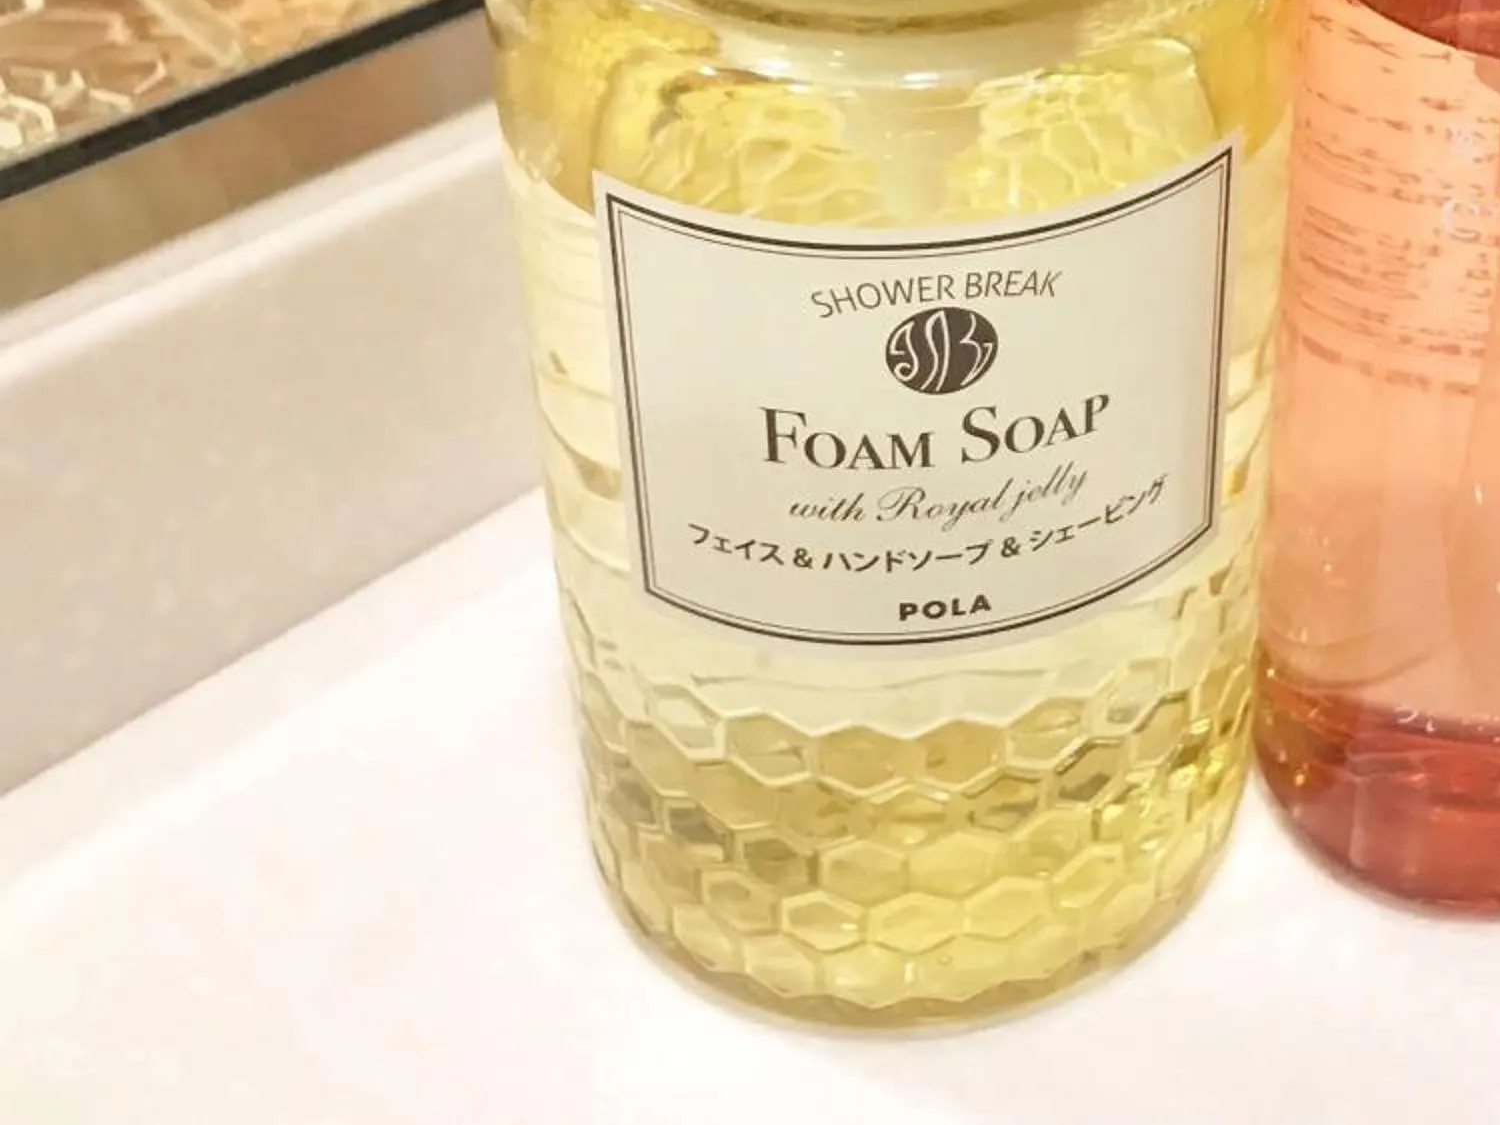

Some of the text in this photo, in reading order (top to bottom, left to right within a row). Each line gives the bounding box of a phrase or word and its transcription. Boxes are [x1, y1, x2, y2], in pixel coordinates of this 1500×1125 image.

[810, 269, 1063, 319] SHOWER BREAK
[758, 393, 1111, 471] FOAM SOAP
[788, 460, 1089, 532] with Royal jelly
[898, 593, 993, 622] POLA
